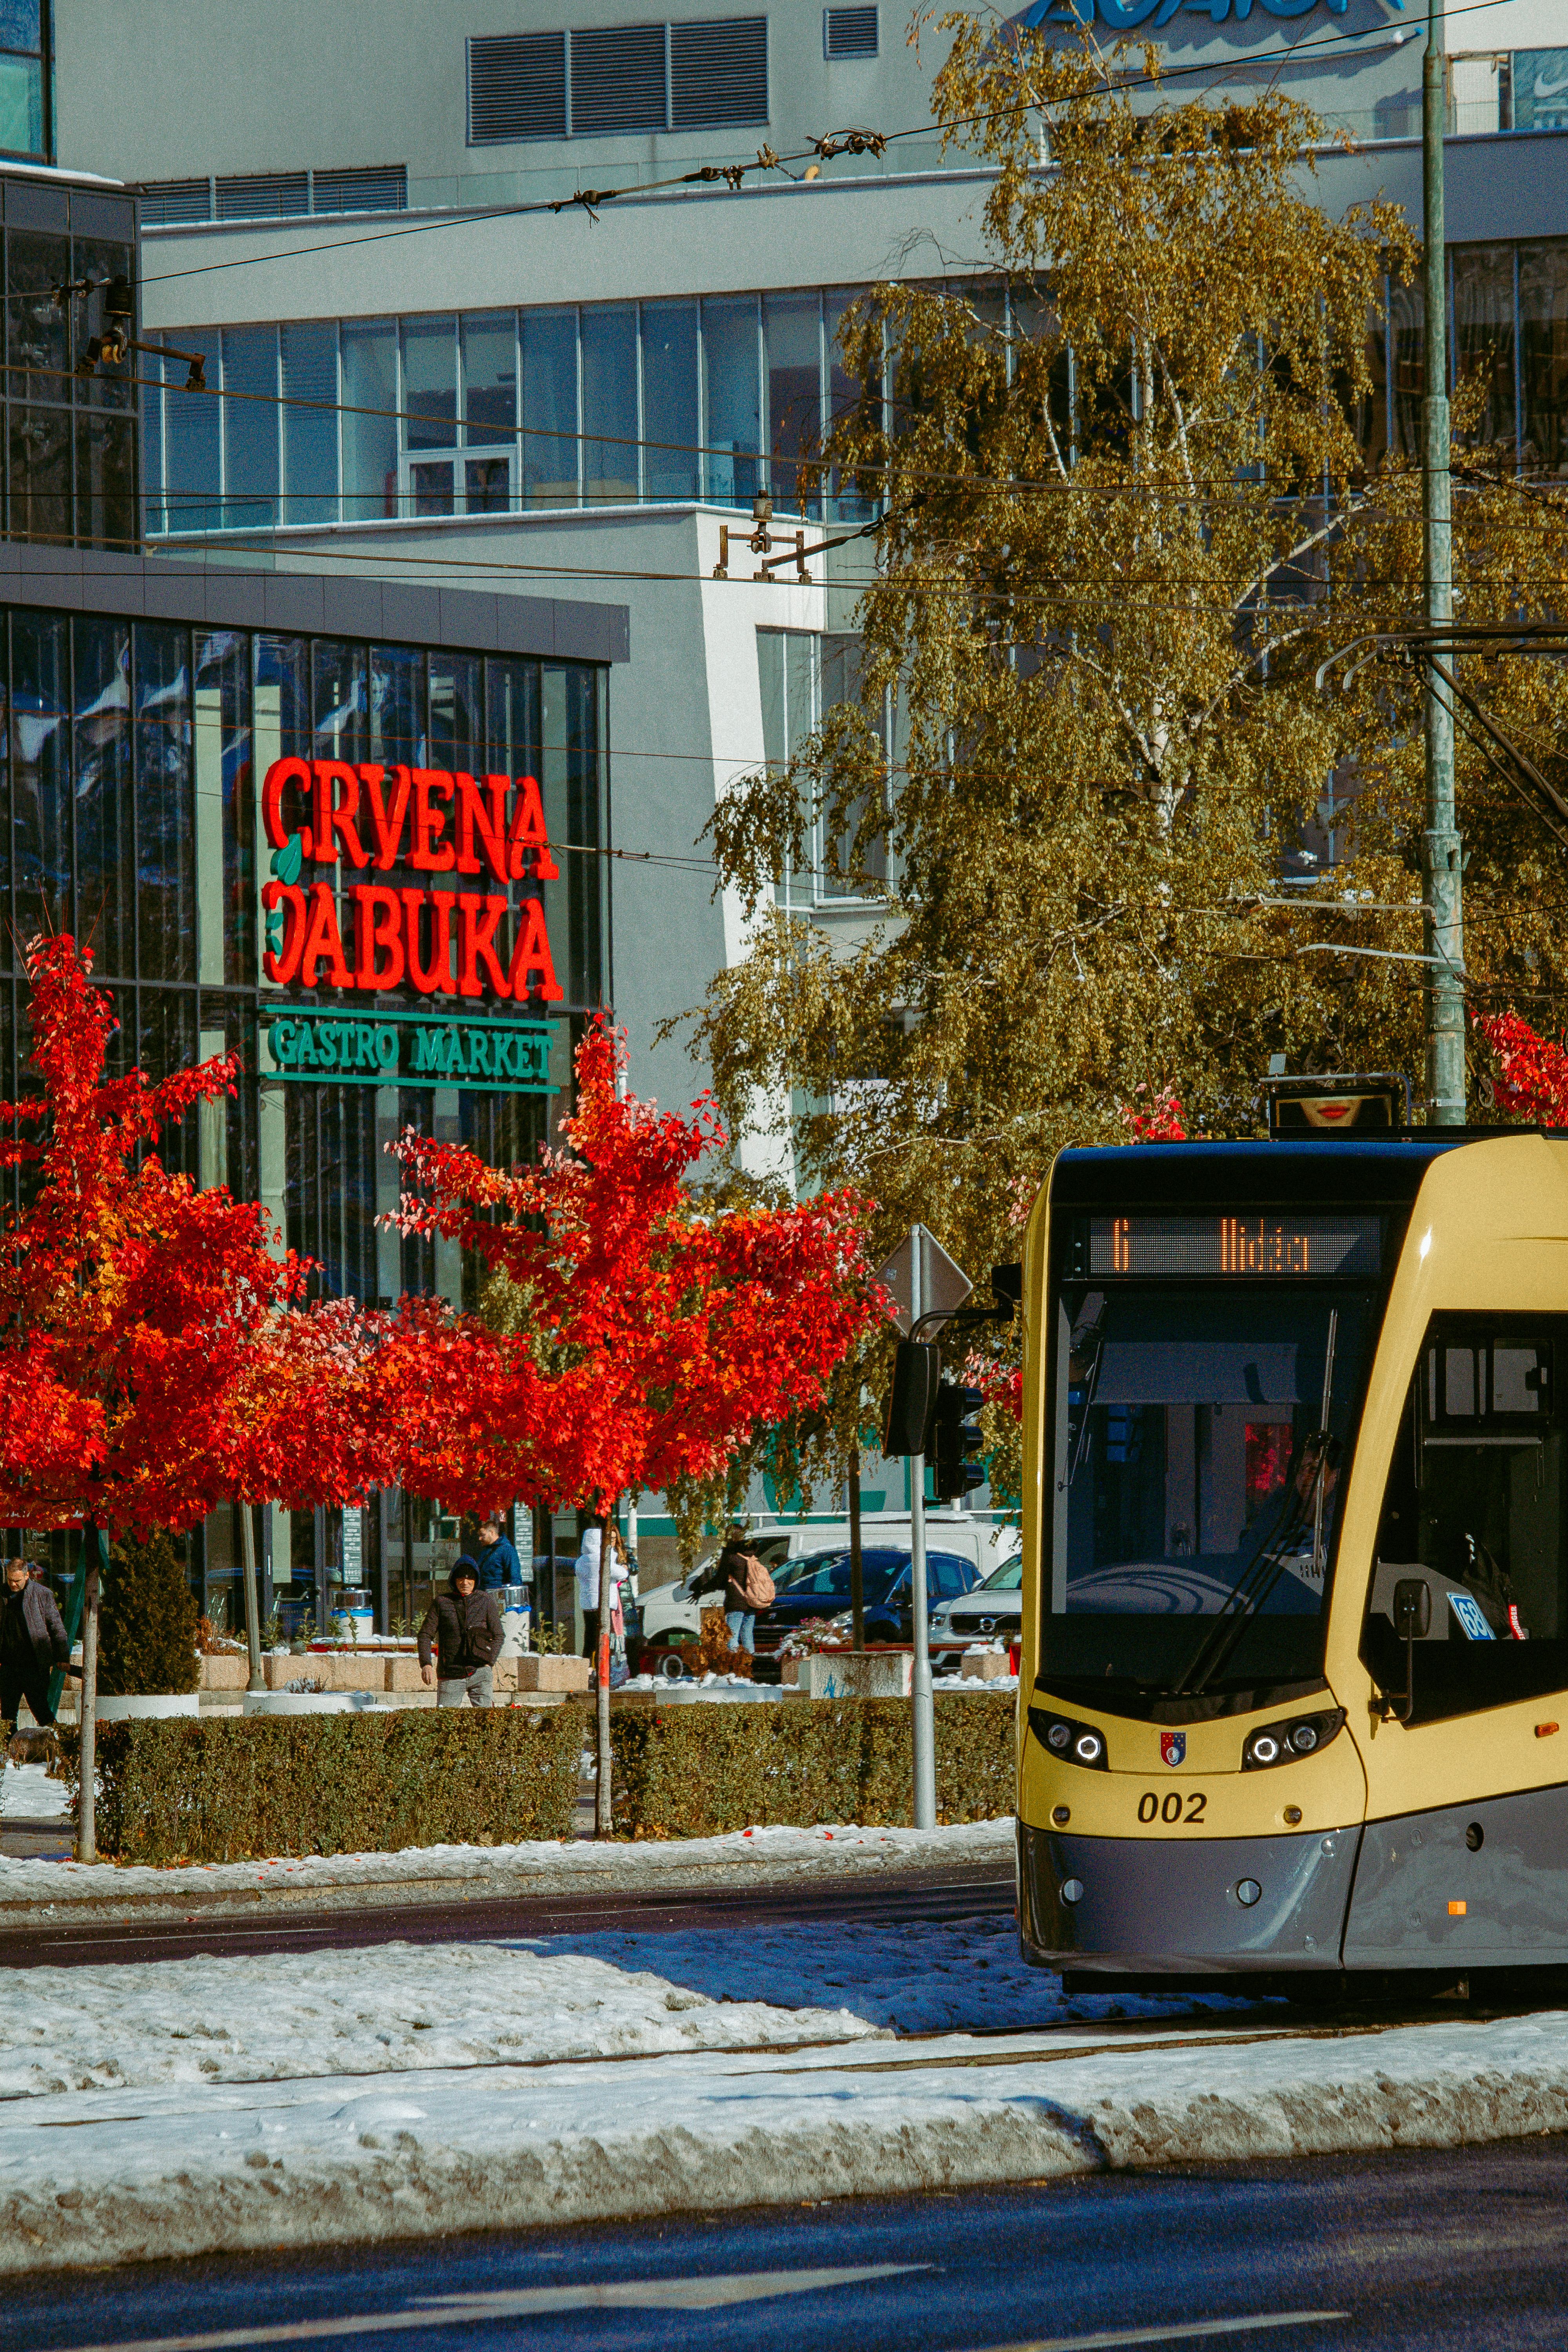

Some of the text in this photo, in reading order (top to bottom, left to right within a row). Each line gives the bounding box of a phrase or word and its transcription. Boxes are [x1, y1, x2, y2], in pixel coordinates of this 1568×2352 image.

[262, 757, 559, 884] CRVENA
[261, 880, 564, 1002] JABUKA
[268, 1020, 553, 1079] GASTRO MARKET
[1113, 1219, 1129, 1271] 6
[1458, 1602, 1488, 1637] 68
[1511, 1606, 1526, 1640] STRONGER
[1137, 1792, 1208, 1824] 002
